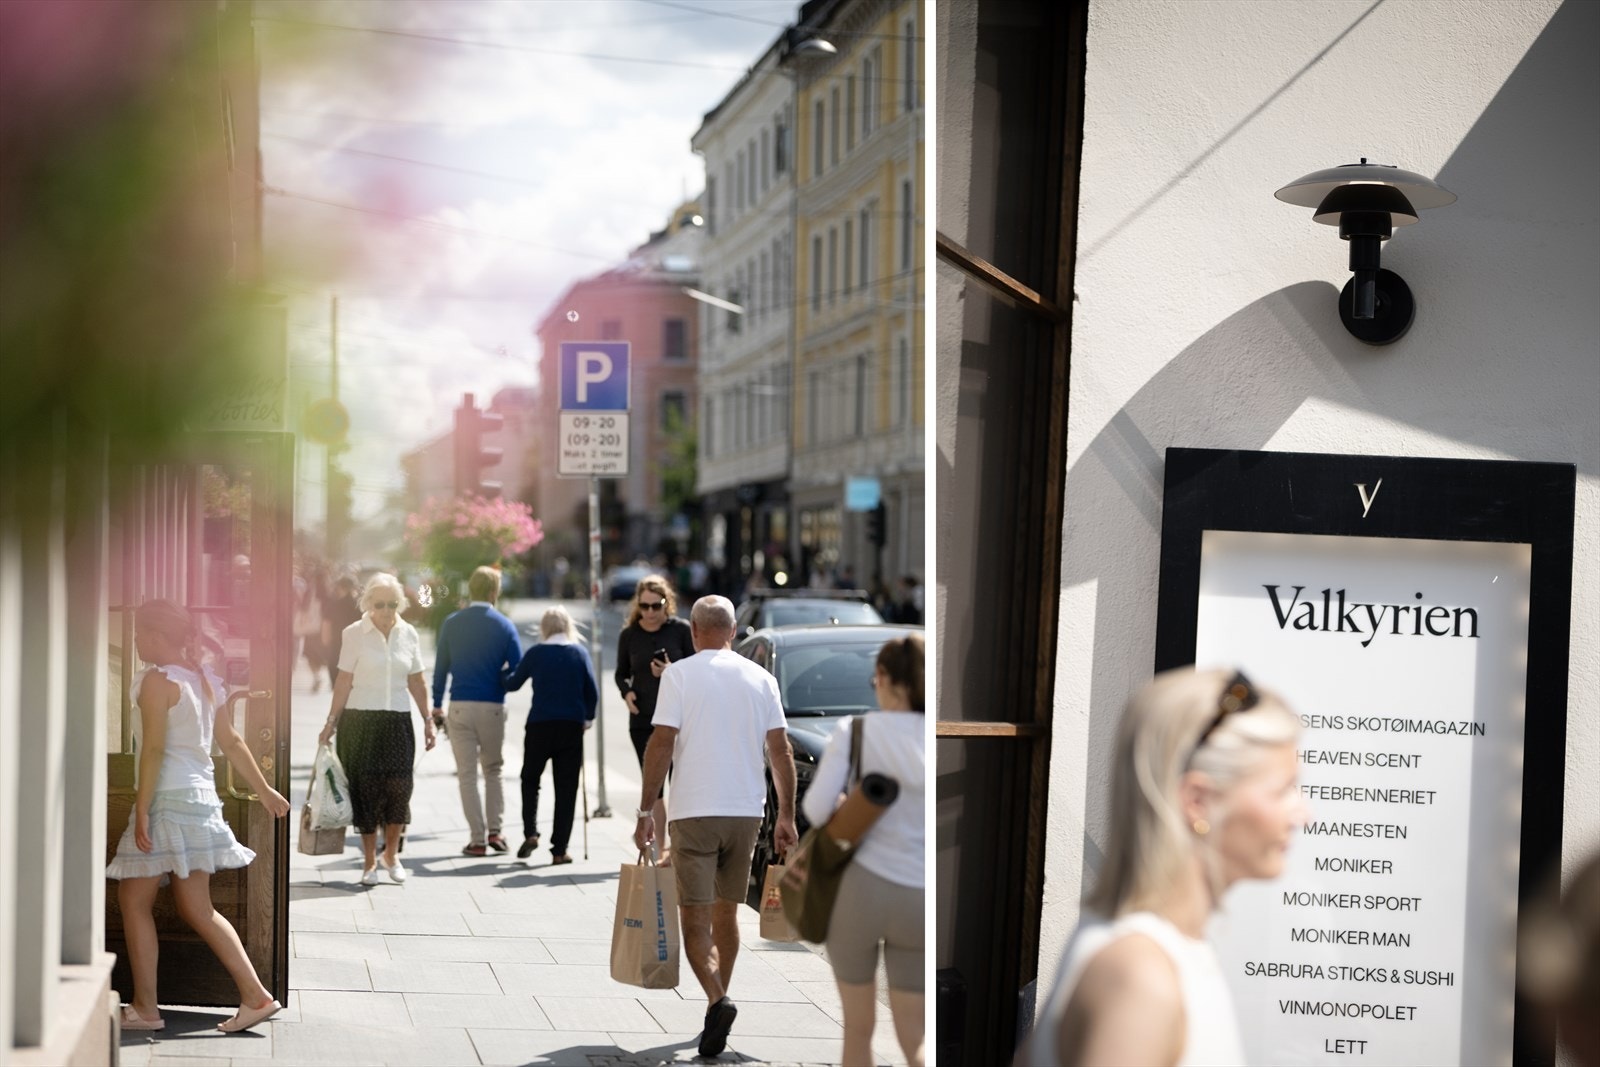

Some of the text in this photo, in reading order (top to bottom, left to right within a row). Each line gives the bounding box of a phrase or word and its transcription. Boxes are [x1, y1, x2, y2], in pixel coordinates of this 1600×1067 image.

[576, 351, 613, 403] P
[1262, 583, 1481, 648] Valkyrien
[1346, 716, 1486, 737] SKOTØIMAGAZIN
[1296, 749, 1422, 769] HEAVEN SCENT
[1300, 784, 1436, 805] FFEBRENNERIET
[1302, 821, 1408, 840] MAANESTEN
[1314, 857, 1393, 875] MONIKER
[1282, 891, 1422, 912] MONIKER SPORT
[1291, 928, 1411, 948] MONIKER MAN
[1244, 961, 1454, 987] SABRURA STICKS & SUSHI
[1278, 999, 1418, 1021] VINMONOPOLET
[1324, 1038, 1368, 1055] LETT
